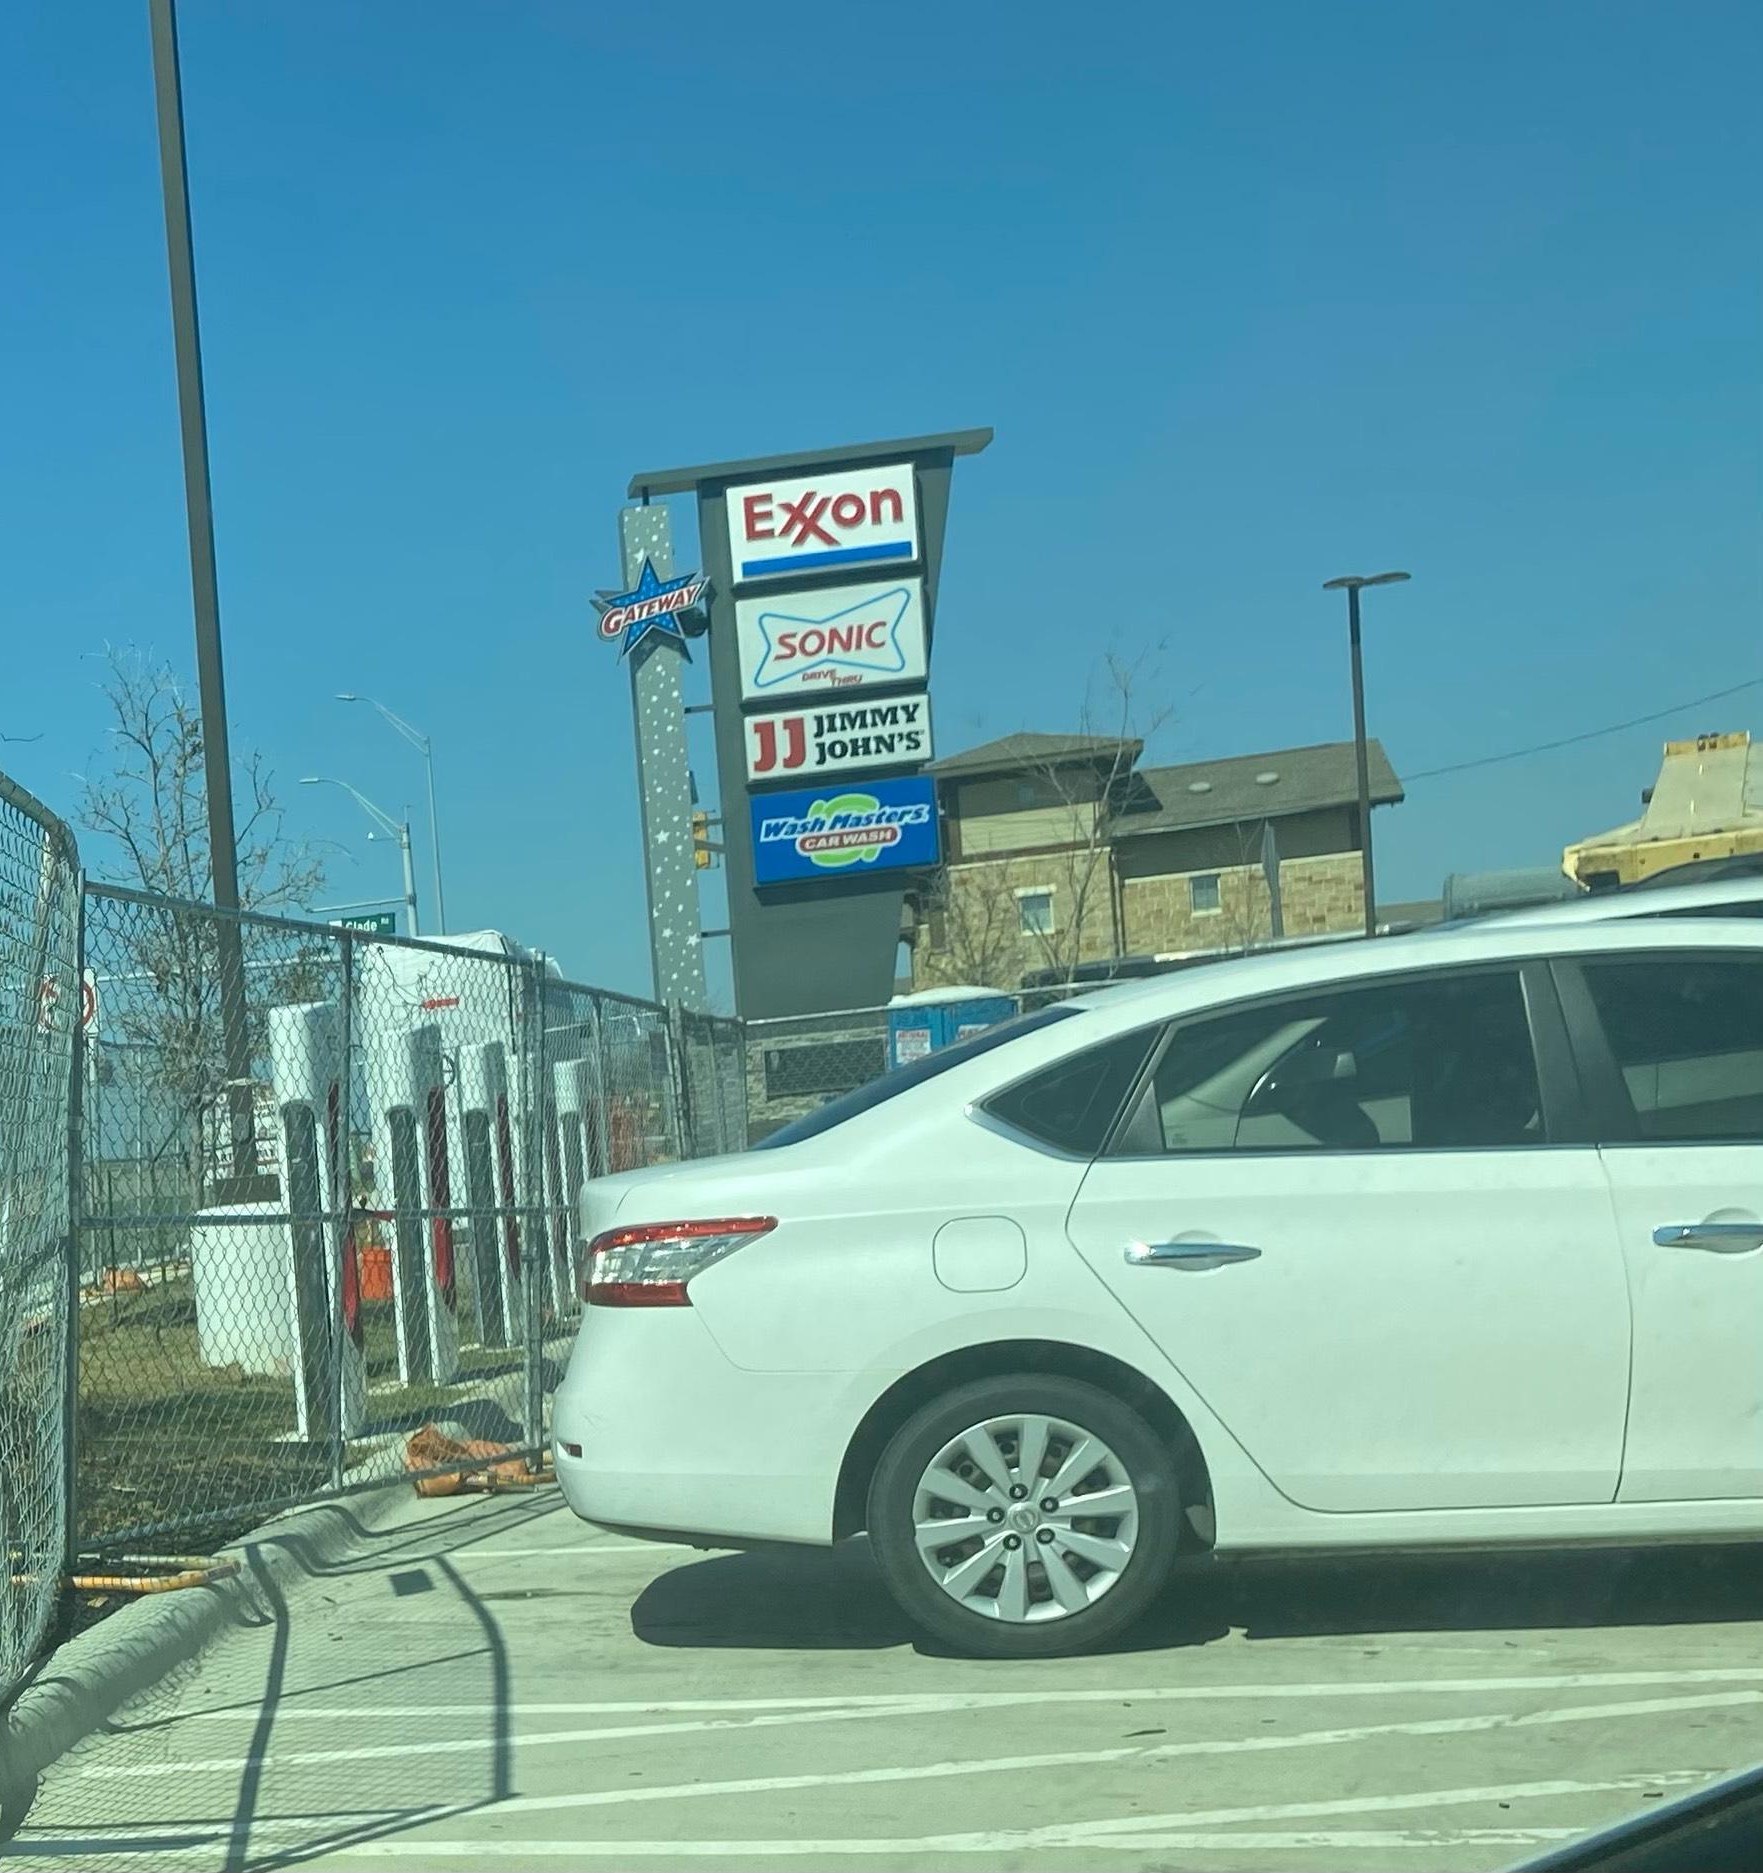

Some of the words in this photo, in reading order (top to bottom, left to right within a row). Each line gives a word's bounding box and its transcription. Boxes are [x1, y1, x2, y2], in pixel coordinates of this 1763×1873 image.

[743, 488, 904, 547] Exxon
[603, 586, 697, 634] GATEWAY
[773, 621, 887, 662] SONIC
[802, 669, 837, 682] DRIVE
[813, 703, 920, 738] JIMMY
[815, 730, 921, 765] JOHN'S
[763, 816, 826, 838] Wash
[828, 806, 925, 830] Masters
[804, 835, 839, 850] CAR
[842, 829, 892, 846] WASH
